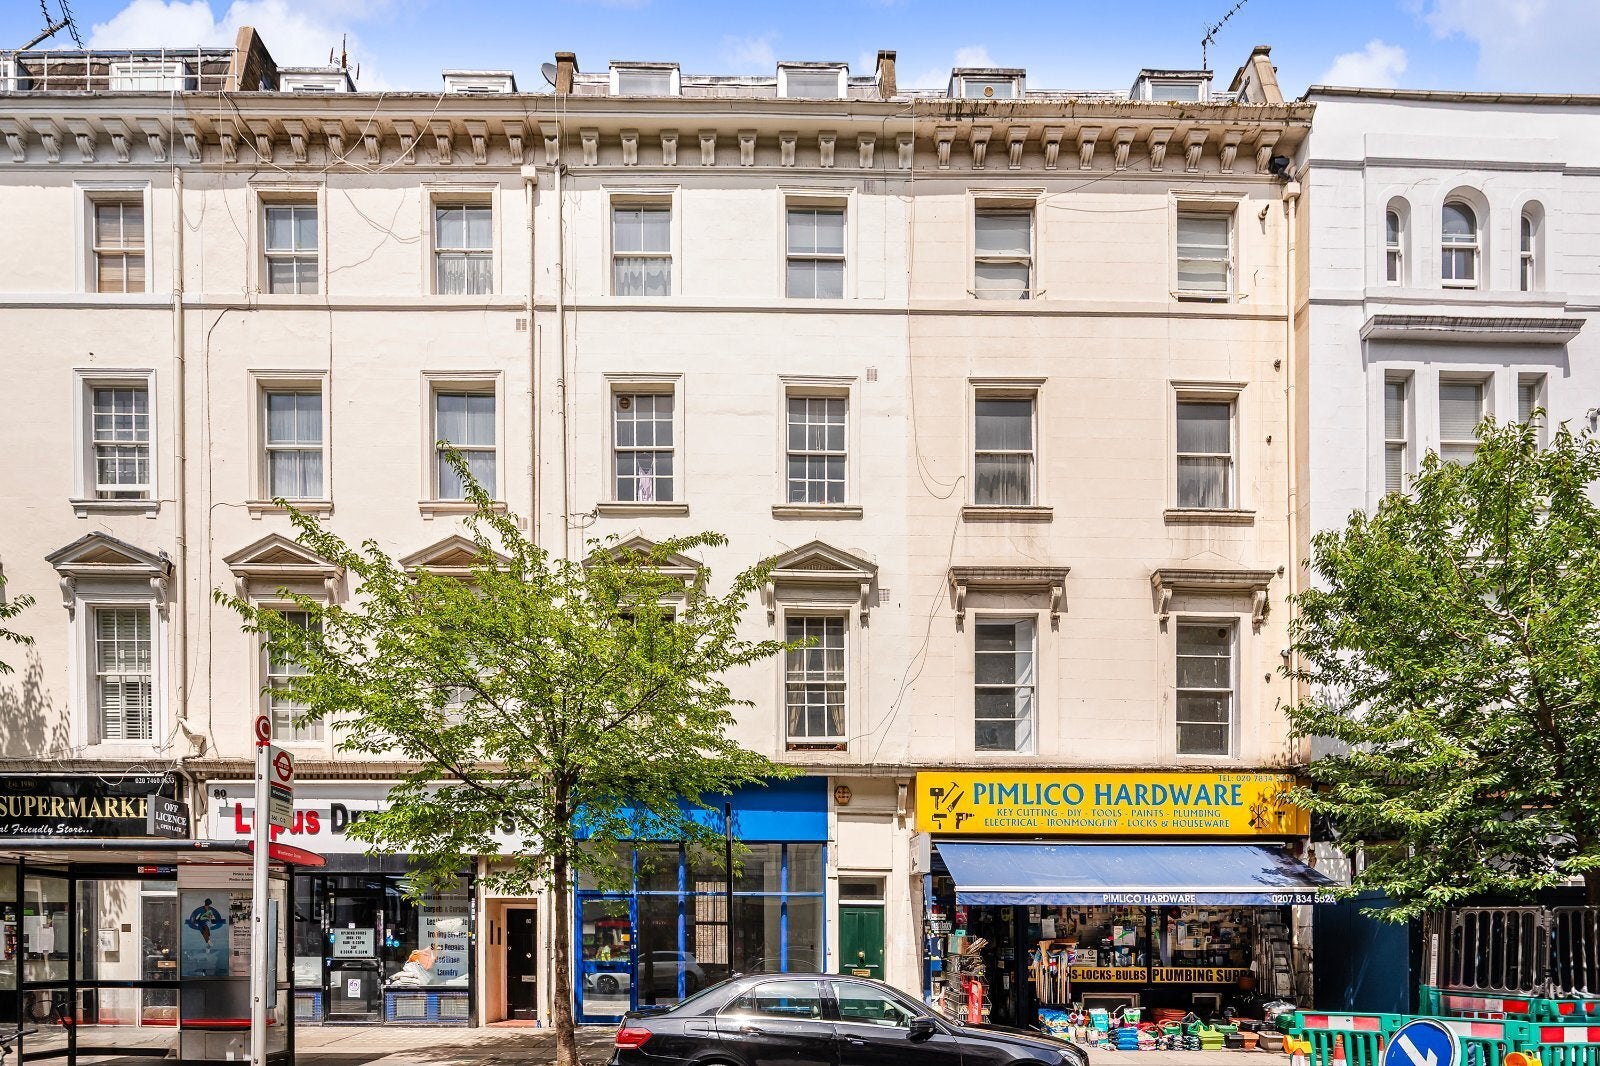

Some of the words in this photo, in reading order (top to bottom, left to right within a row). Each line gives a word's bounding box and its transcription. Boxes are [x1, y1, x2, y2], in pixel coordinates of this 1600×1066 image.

[1219, 774, 1233, 782] TEL:
[213, 789, 227, 799] 80
[973, 782, 1085, 806] PIMLICO
[1094, 783, 1244, 807] HARDWARE
[0, 796, 148, 819] SUPERMARKE
[164, 802, 179, 813] OFF
[996, 808, 1013, 817] KEY
[1016, 808, 1058, 818] CUTTING
[1067, 808, 1082, 818] DIY
[1092, 809, 1122, 818] TOOLS
[1131, 809, 1164, 818] PAINTS
[1173, 809, 1221, 818] PLUMBING
[155, 811, 188, 827] LICENCE
[235, 803, 321, 842] Lpus
[984, 818, 1038, 827] ELECTRICAL
[1047, 818, 1118, 827] IRONMONGERY
[1127, 819, 1158, 828] LOCKS
[1161, 820, 1169, 828] &
[1172, 819, 1230, 828] HOUSEWARE
[11, 824, 55, 836] Friendly
[1103, 894, 1142, 904] PIMLICO
[1143, 894, 1195, 904] HARDWARE
[1272, 894, 1293, 903] 0207
[1296, 894, 1312, 903] 834
[437, 968, 459, 977] Laundry
[1152, 968, 1214, 983] PLUMBING
